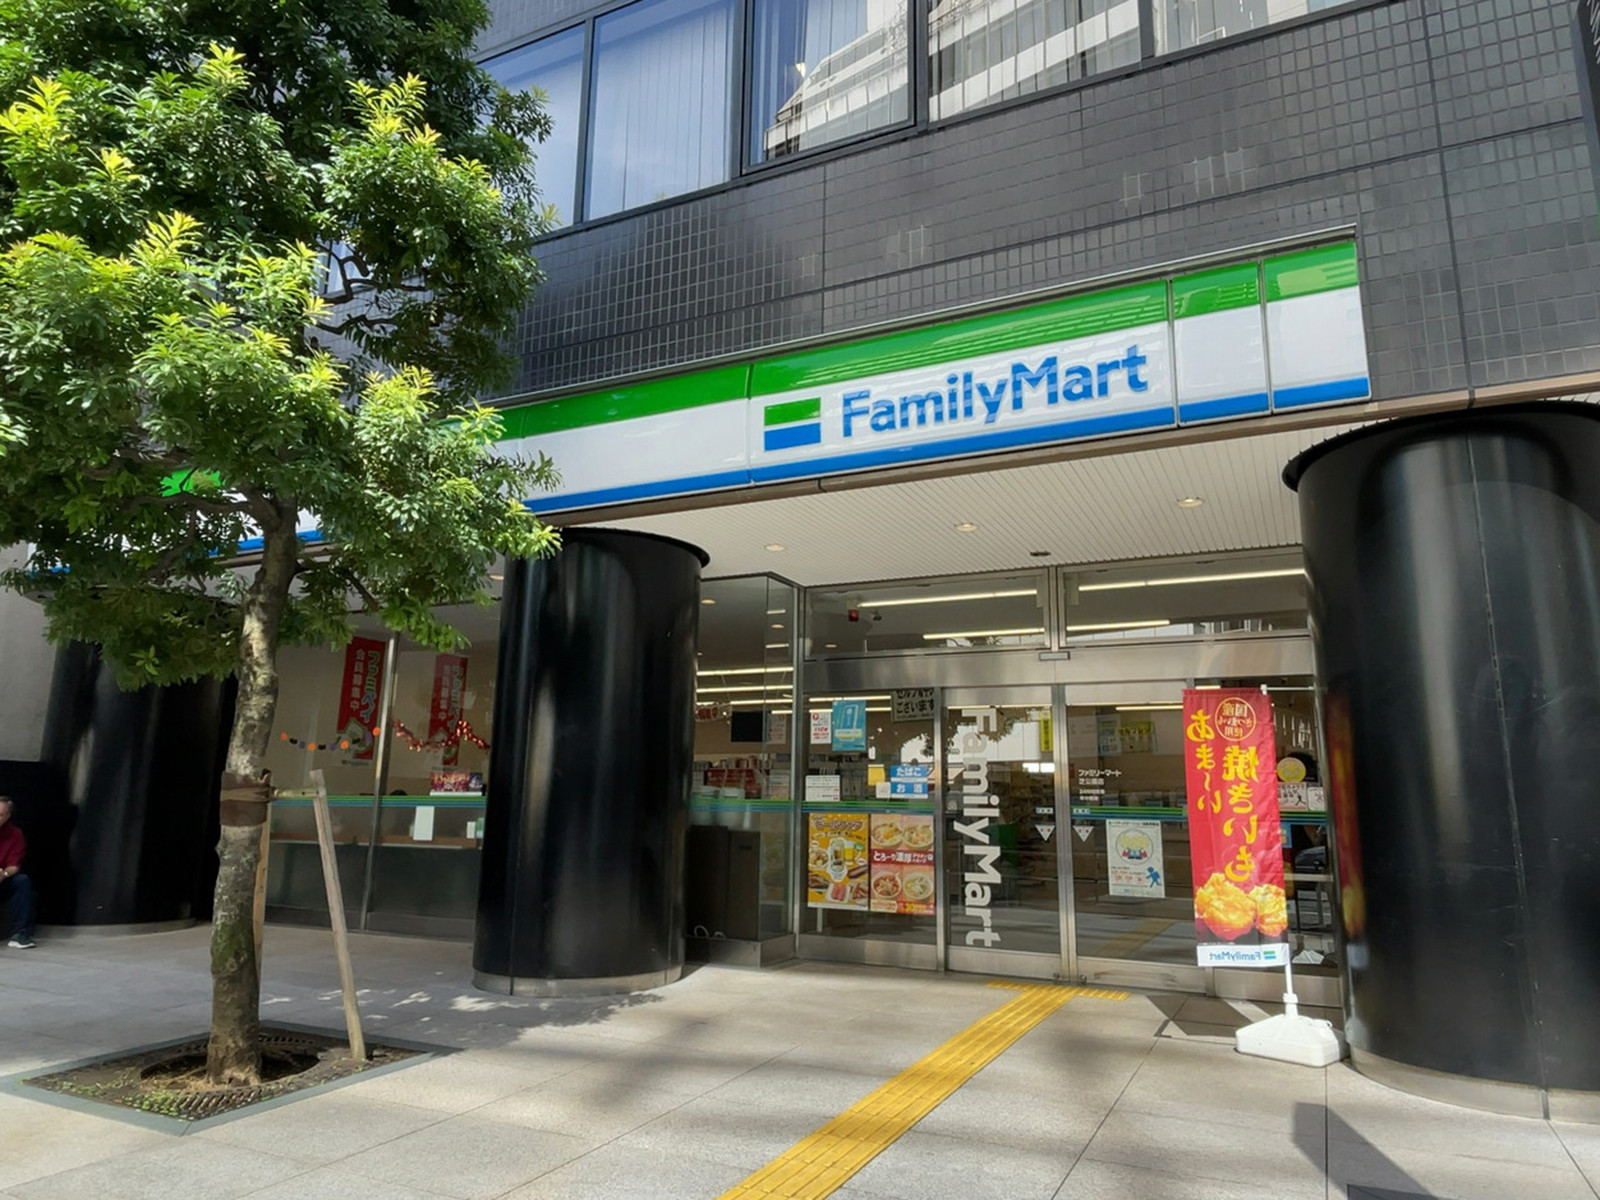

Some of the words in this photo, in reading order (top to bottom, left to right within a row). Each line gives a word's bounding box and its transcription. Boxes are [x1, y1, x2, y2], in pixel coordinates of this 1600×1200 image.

[843, 344, 1149, 438] FamilyMart
[896, 767, 922, 777] たばこ
[1078, 769, 1122, 777] ファミリーマート
[953, 708, 1001, 947] FamilyMart
